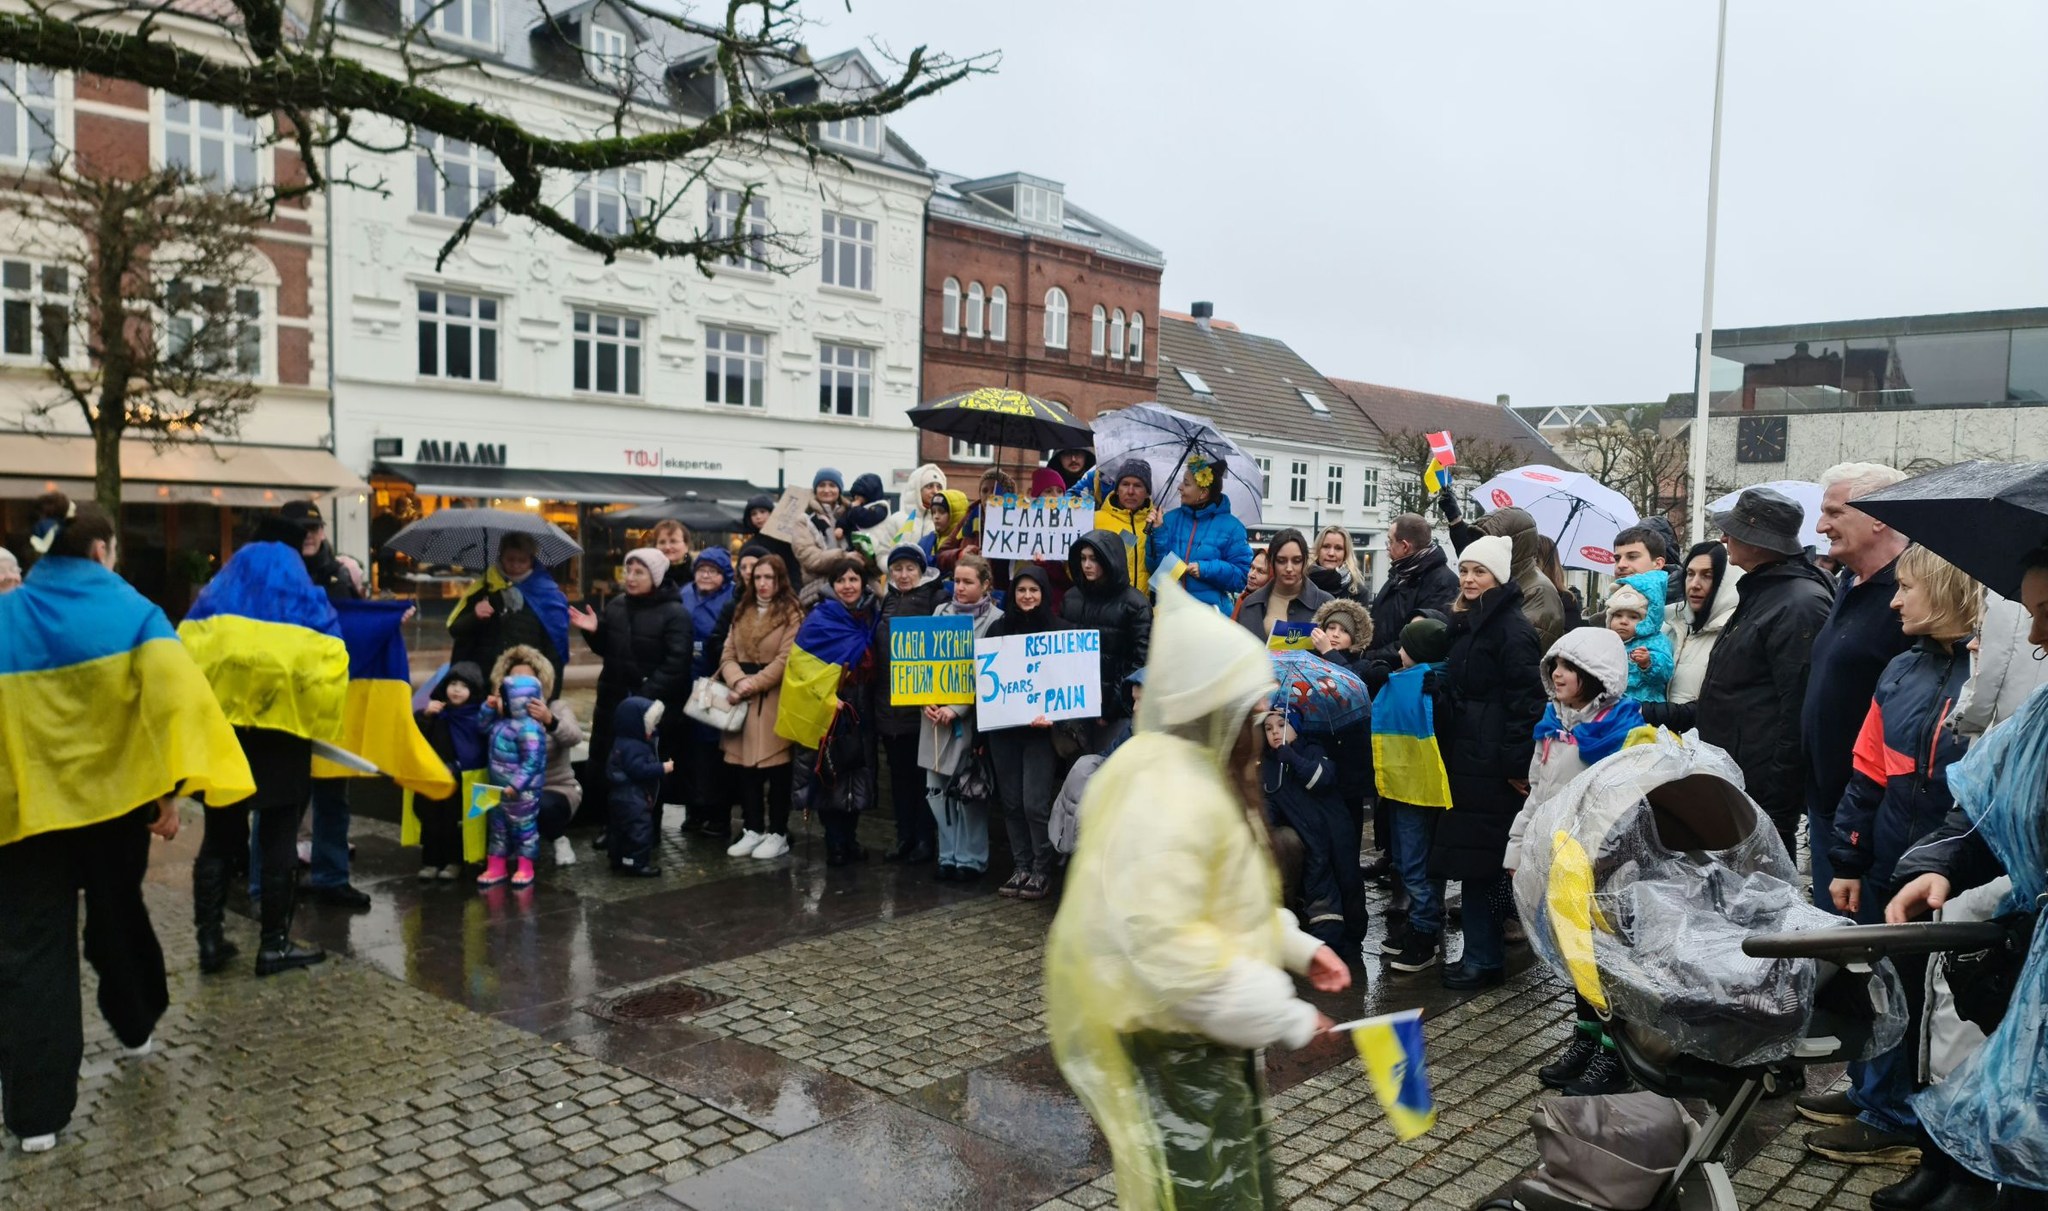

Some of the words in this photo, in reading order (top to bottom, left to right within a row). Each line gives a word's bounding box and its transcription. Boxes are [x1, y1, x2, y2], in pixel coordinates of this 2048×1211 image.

[416, 438, 506, 465] MIAMI
[664, 457, 723, 470] eksperten
[1001, 507, 1074, 528] СЛАВА
[891, 630, 926, 659] СЛАВА
[1025, 631, 1099, 657] RESILIENCE
[891, 664, 933, 694] ГЕРОЯМ
[939, 663, 976, 694] СЛАВА
[977, 651, 1000, 703] 3
[1000, 678, 1034, 705] YEARS
[1026, 660, 1041, 674] OF
[1026, 692, 1041, 704] OF
[1044, 684, 1086, 713] PAIN
